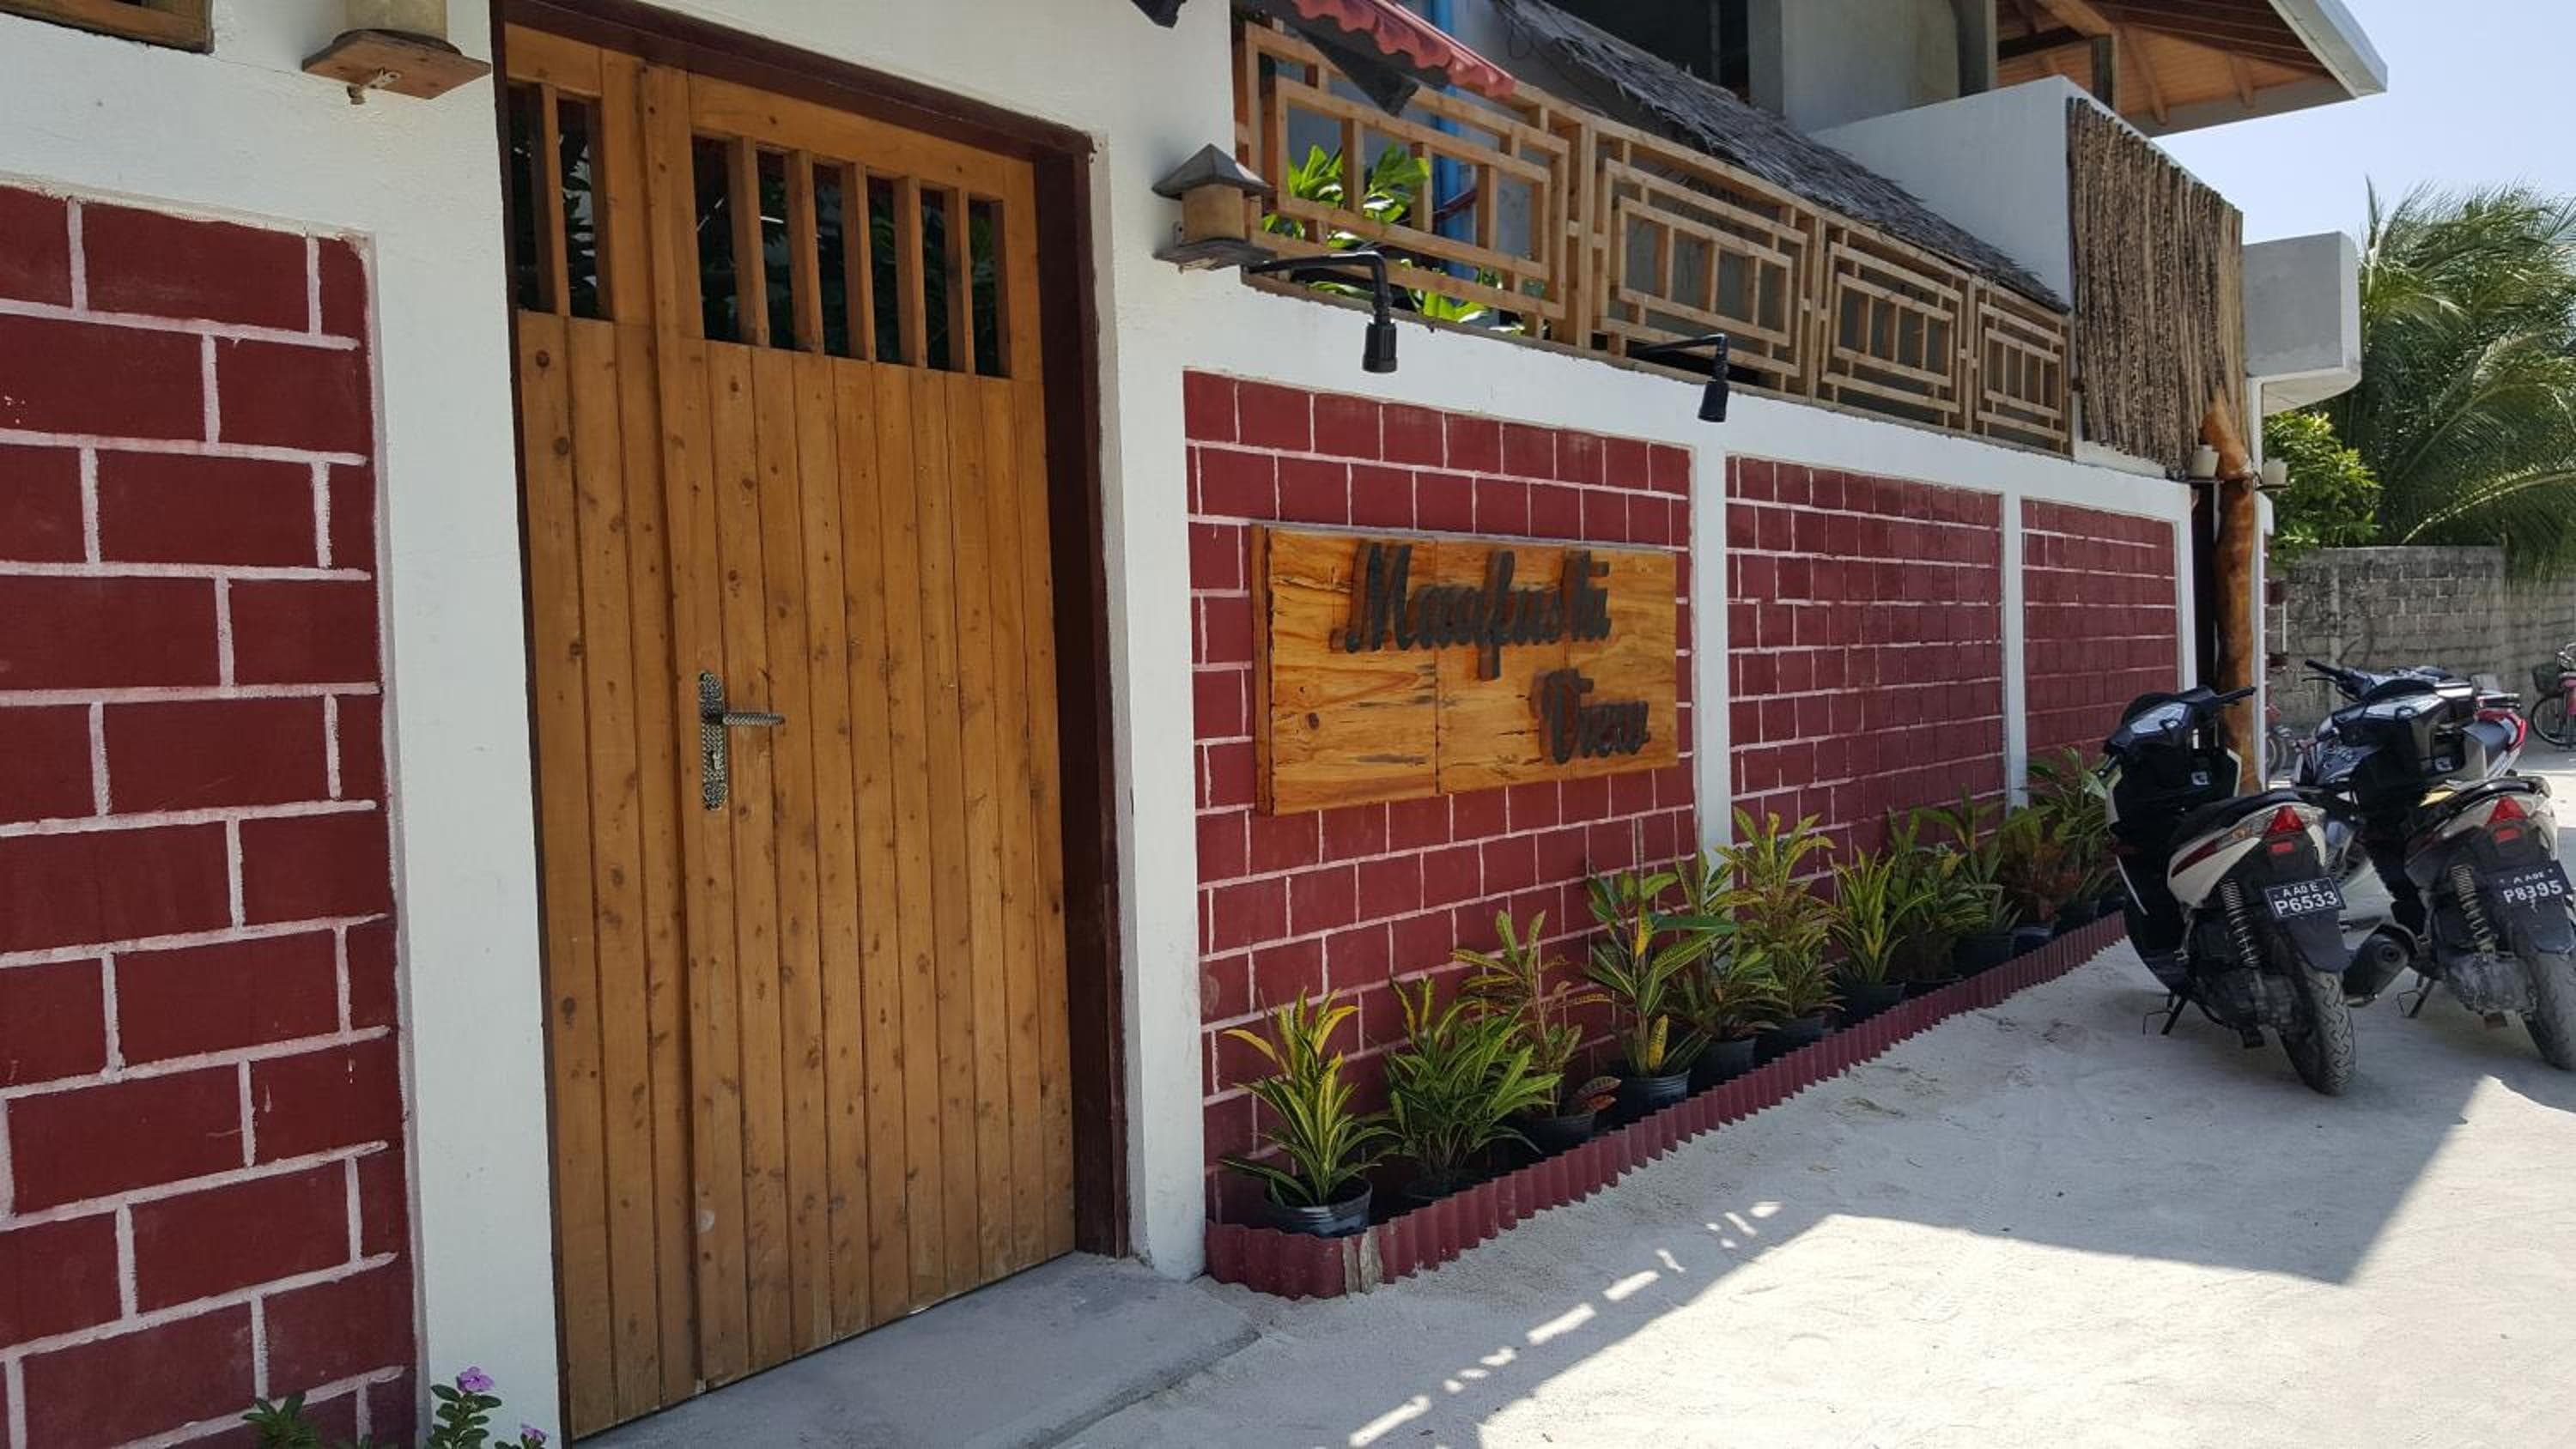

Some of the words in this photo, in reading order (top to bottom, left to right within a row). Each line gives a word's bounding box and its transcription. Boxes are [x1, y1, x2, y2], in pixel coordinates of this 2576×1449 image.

[1530, 667, 1651, 764] View
[2274, 891, 2337, 915] P6533
[2503, 880, 2563, 904] P8395
